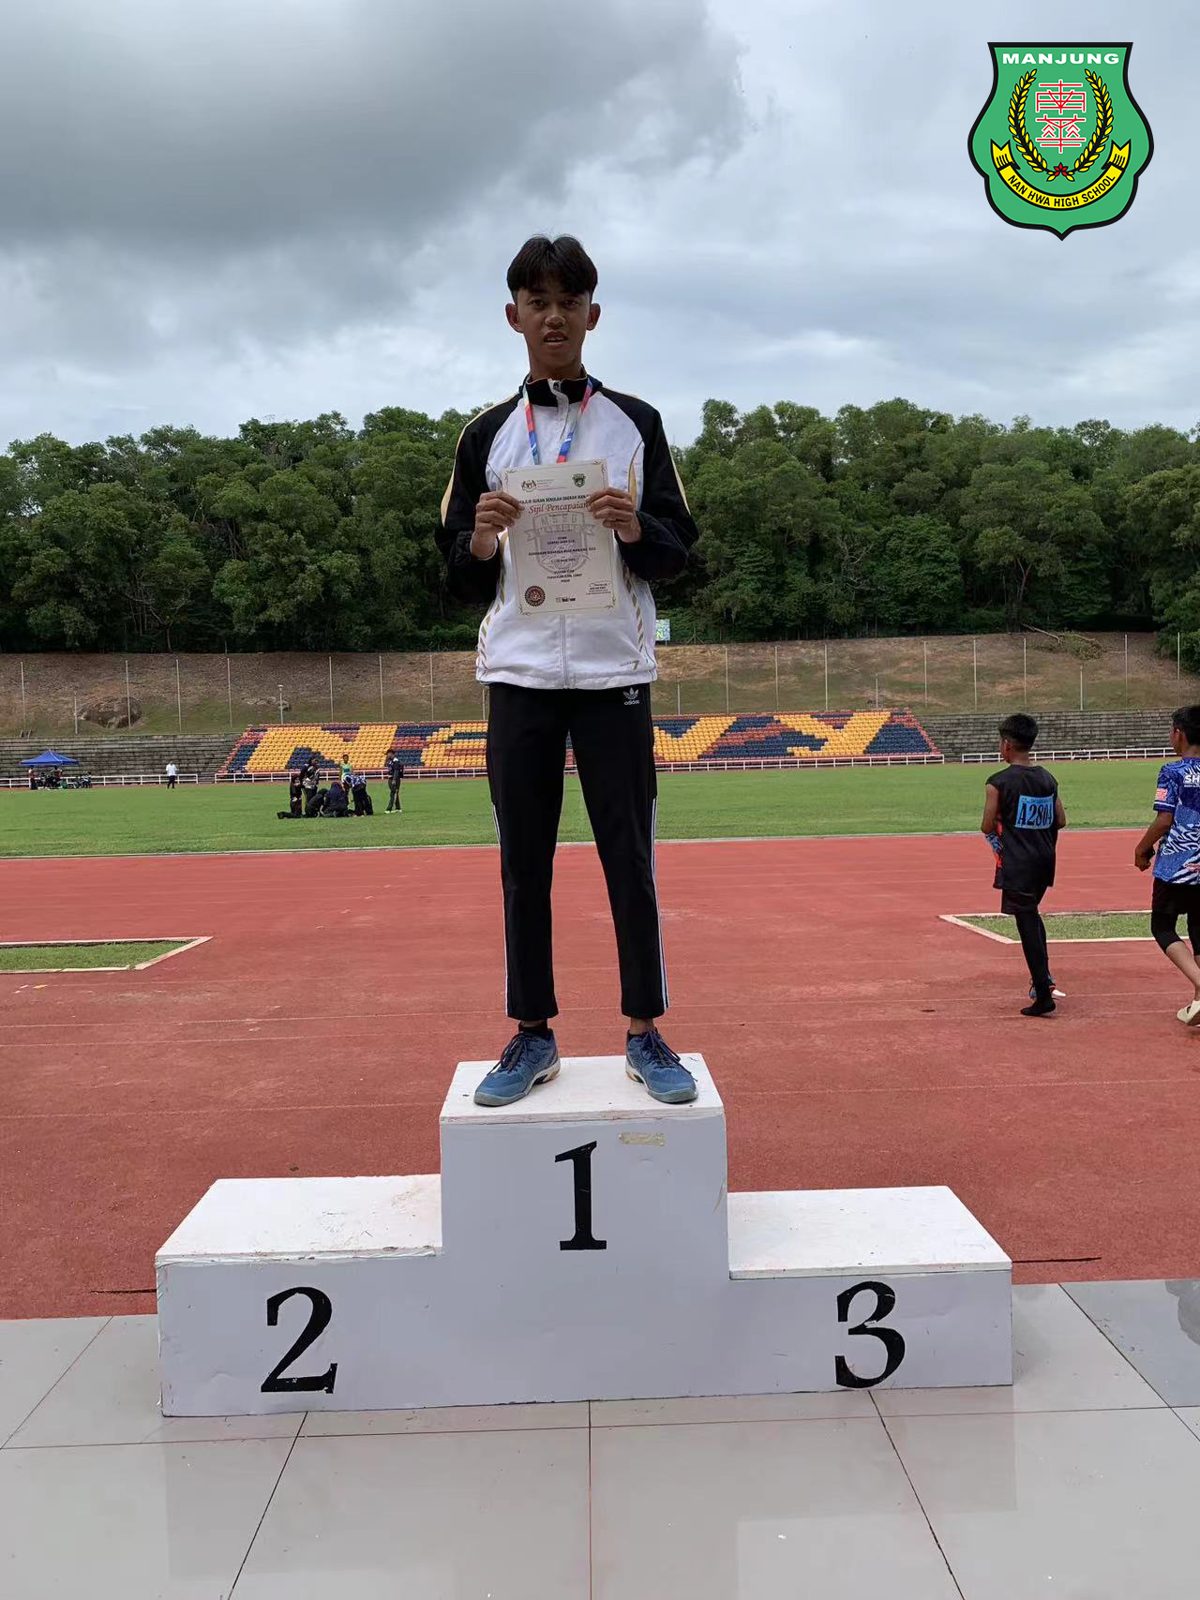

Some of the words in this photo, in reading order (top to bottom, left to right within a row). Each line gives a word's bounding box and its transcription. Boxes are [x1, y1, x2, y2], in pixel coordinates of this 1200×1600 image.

[554, 1140, 608, 1251] 1
[260, 1286, 338, 1394] 2
[834, 1281, 906, 1389] 3
